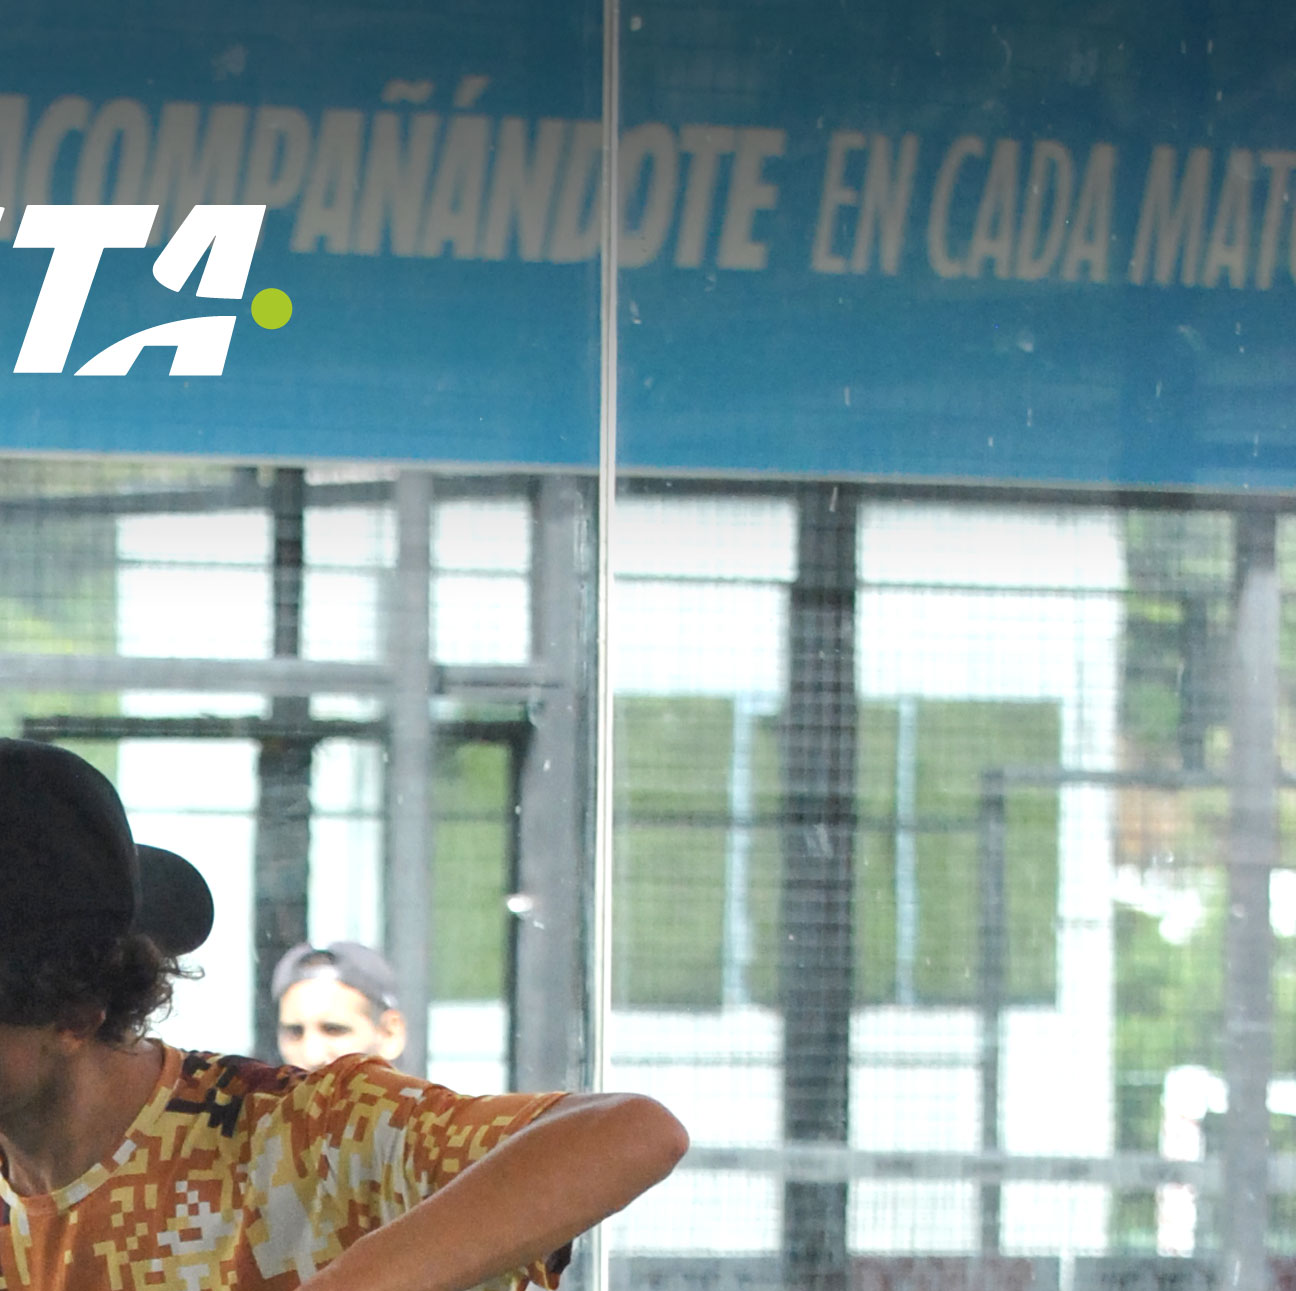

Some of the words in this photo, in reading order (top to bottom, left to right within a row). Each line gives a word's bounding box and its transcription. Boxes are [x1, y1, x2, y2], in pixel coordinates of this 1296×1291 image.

[811, 131, 918, 277] EN
[926, 135, 1118, 285] CADA
[1128, 144, 1296, 291] MAT
